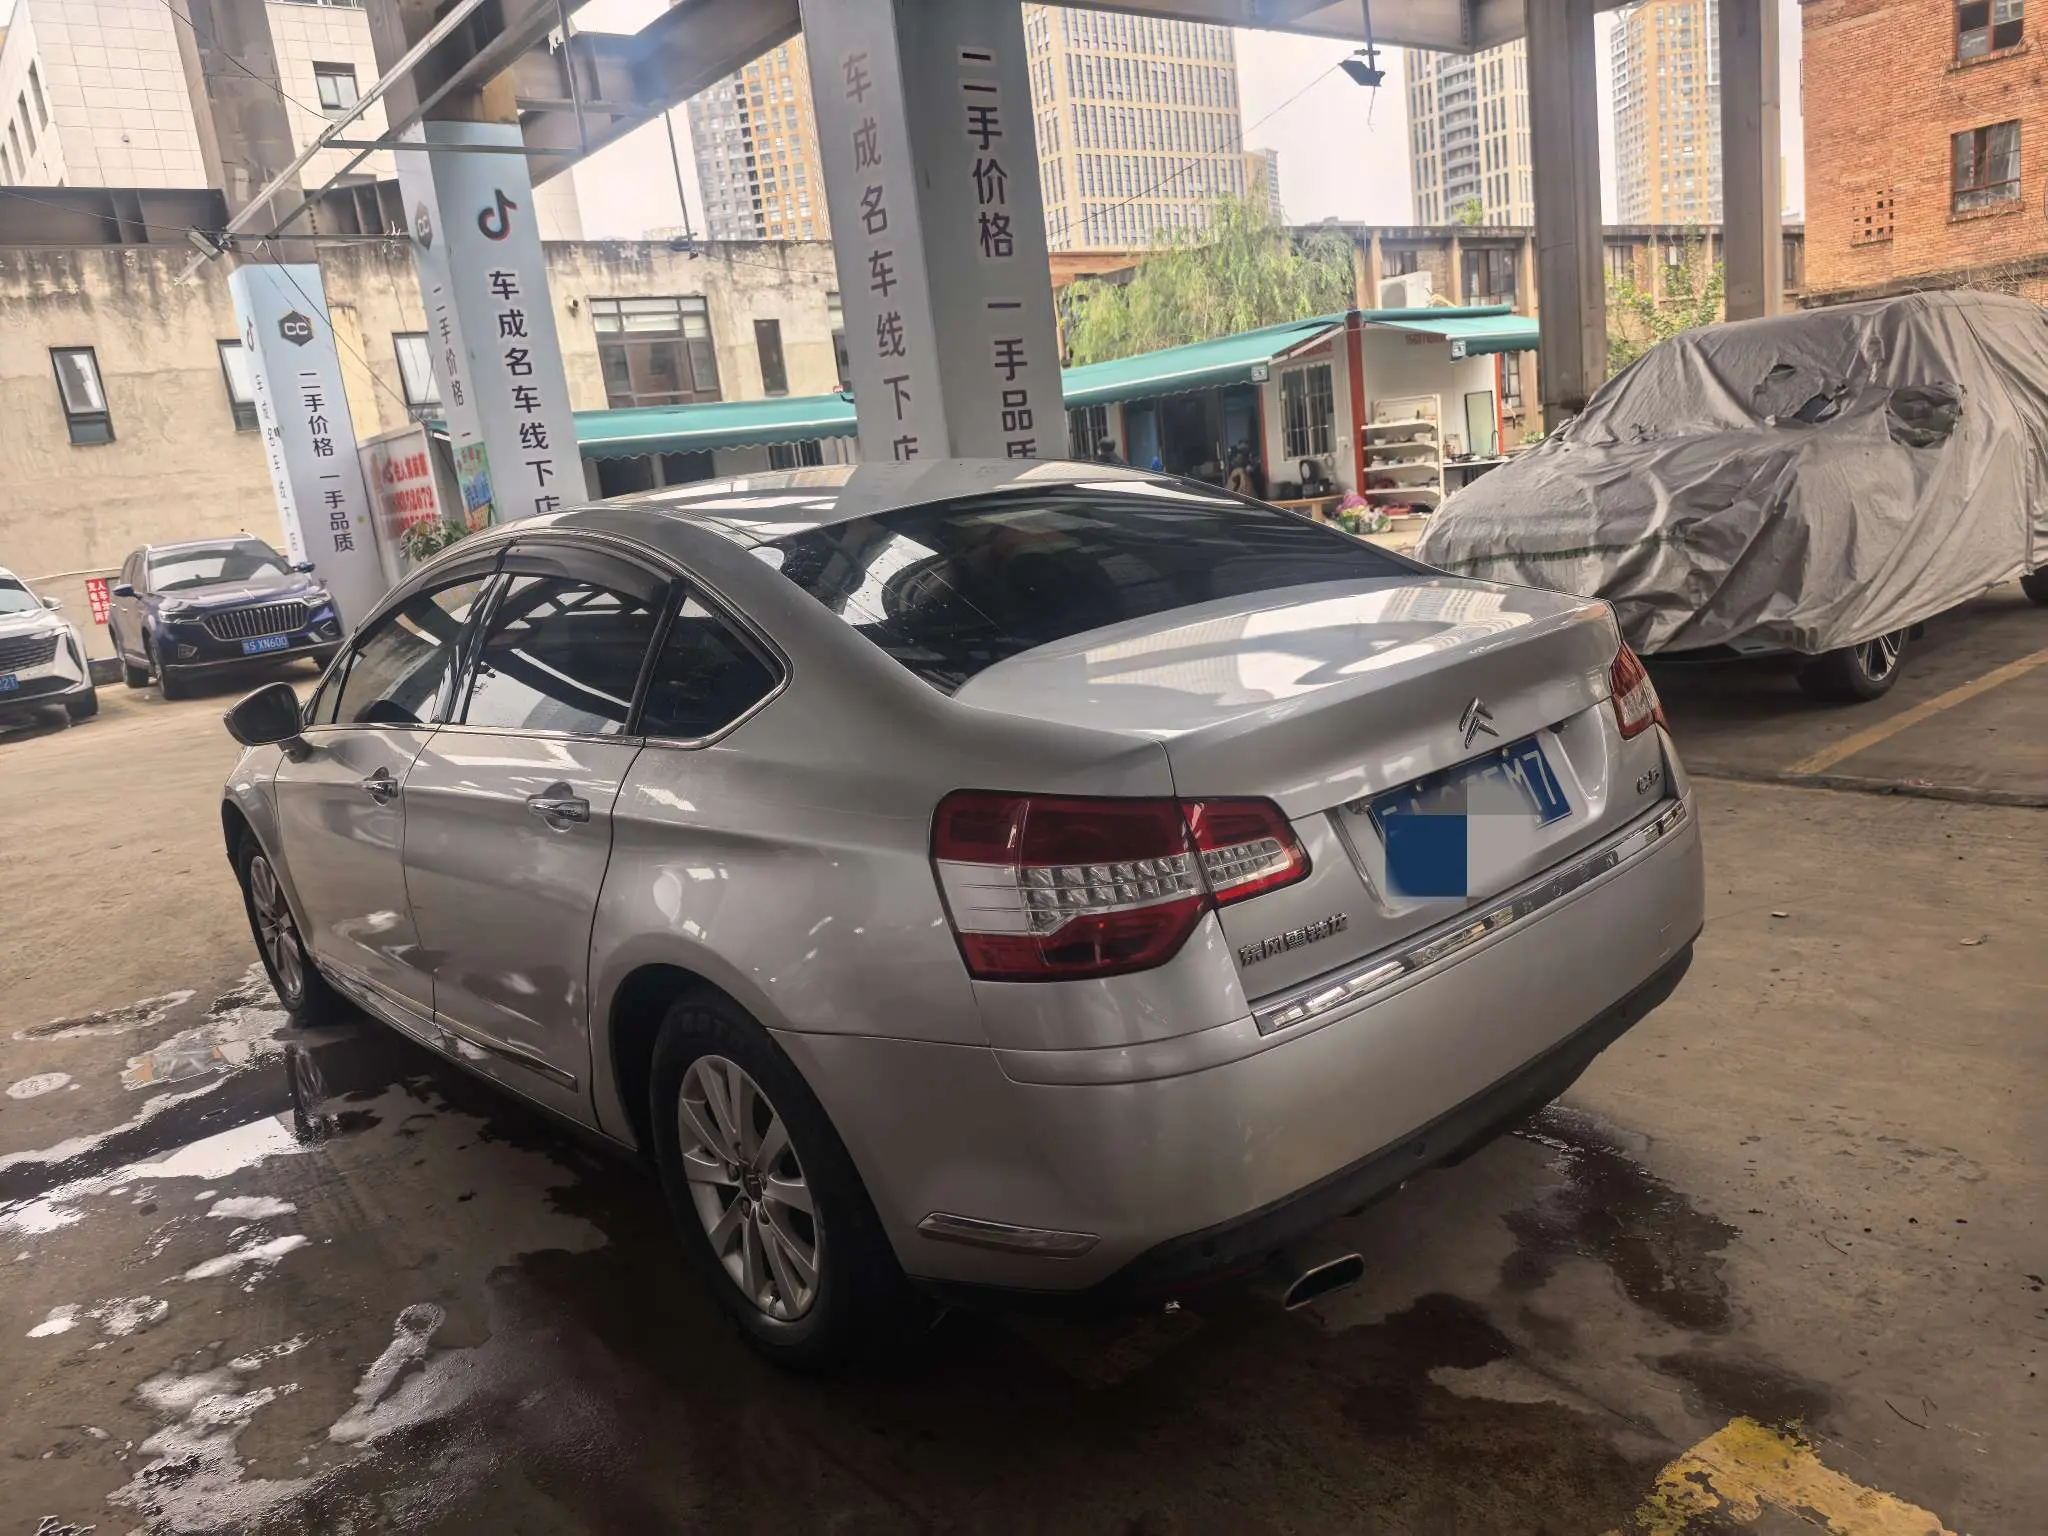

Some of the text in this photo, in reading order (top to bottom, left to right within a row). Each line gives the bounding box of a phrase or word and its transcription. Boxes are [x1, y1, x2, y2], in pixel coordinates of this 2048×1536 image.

[961, 52, 1014, 258] 二手价格
[284, 322, 308, 336] CC
[432, 287, 464, 407] 二手价格
[489, 271, 560, 513] 车成名车线下店
[299, 372, 355, 553] 二手价格 一手品质
